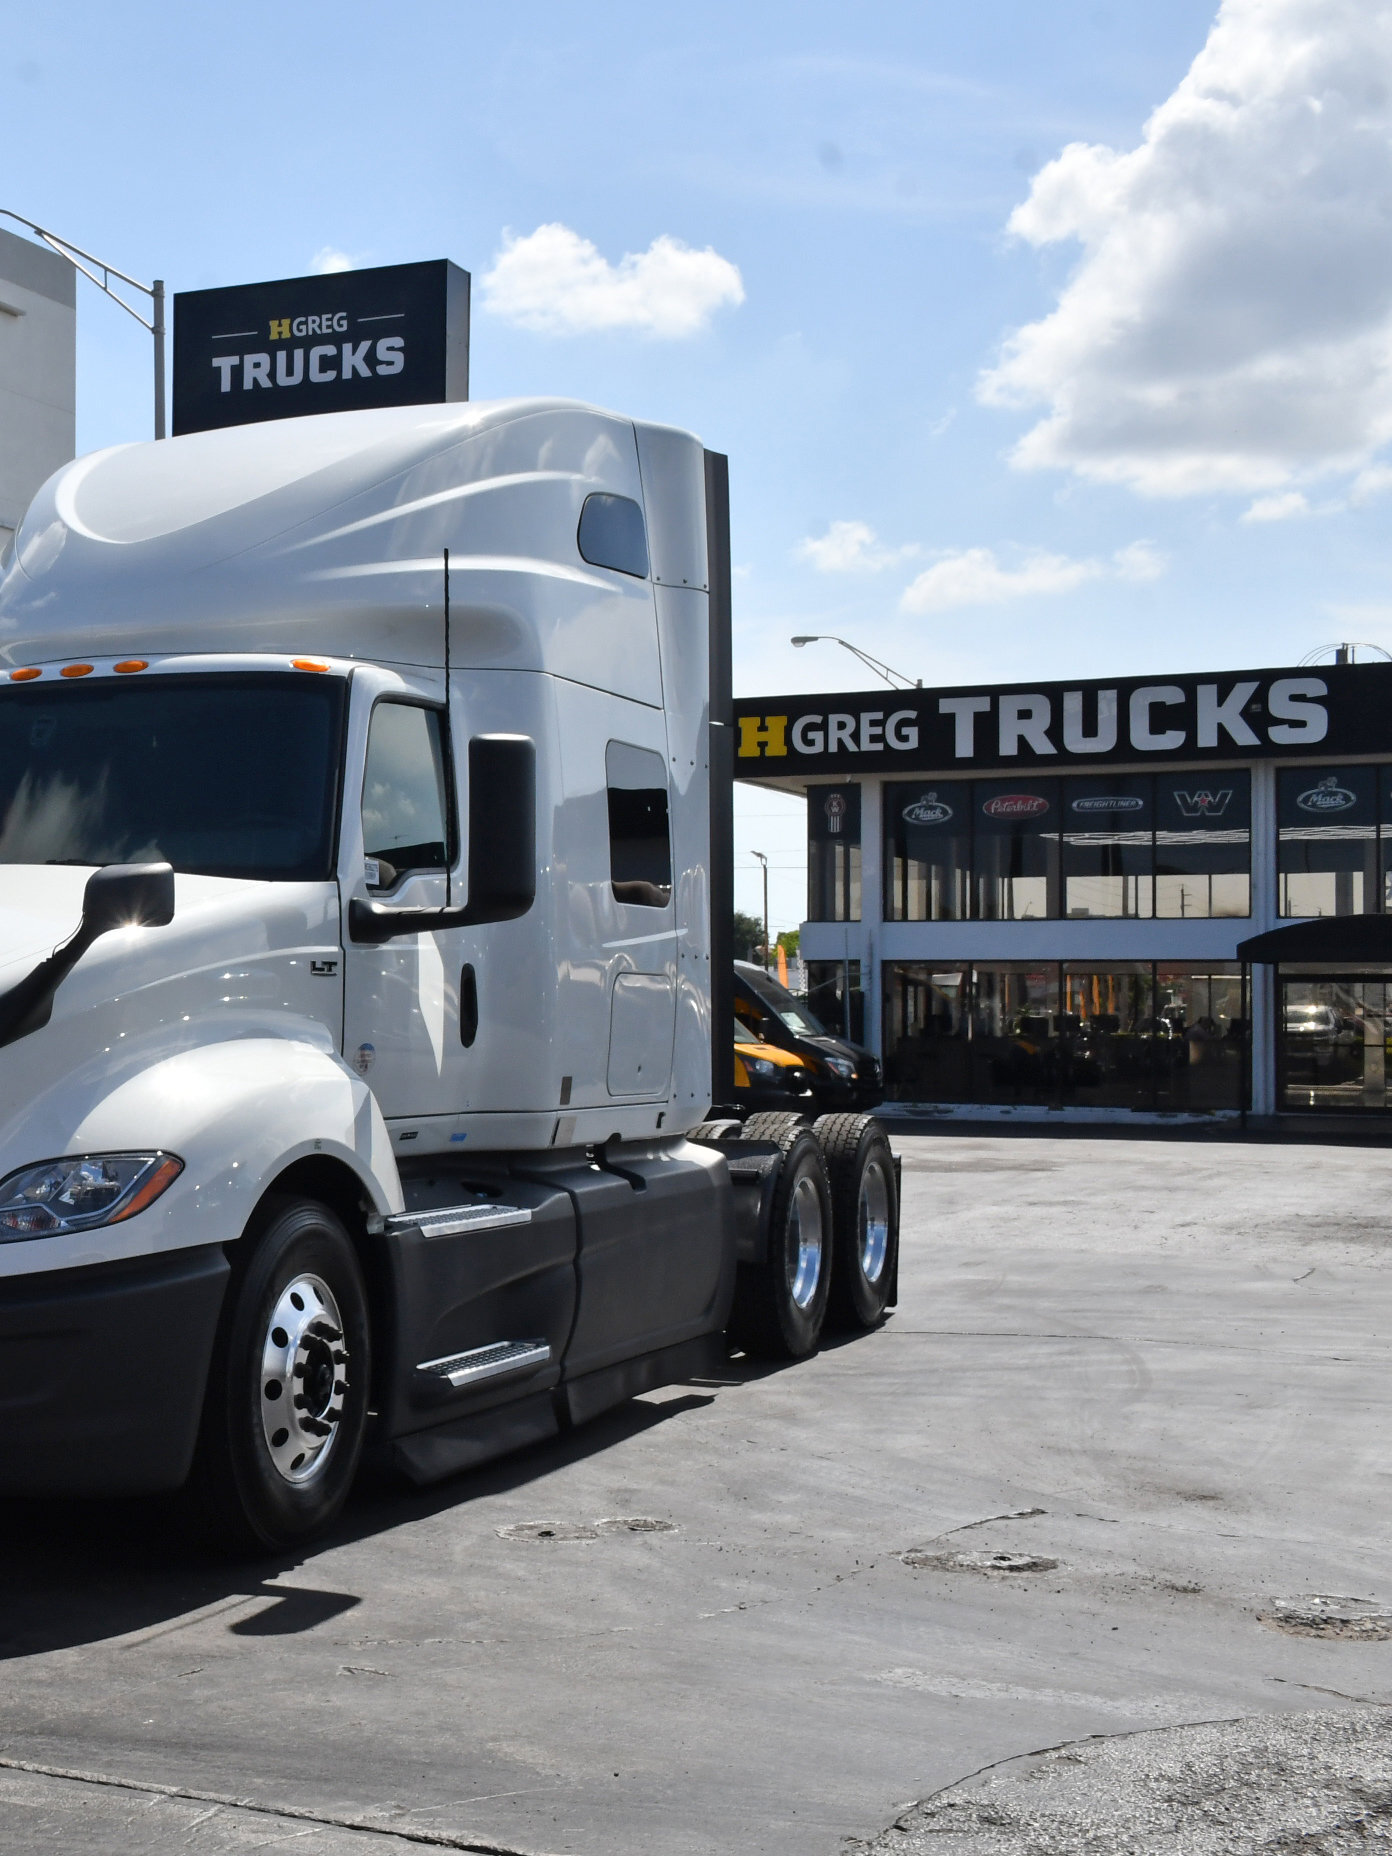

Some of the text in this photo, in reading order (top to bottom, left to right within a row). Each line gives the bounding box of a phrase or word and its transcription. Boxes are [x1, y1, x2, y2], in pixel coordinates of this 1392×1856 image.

[212, 336, 405, 393] TRUCKS
[939, 677, 1329, 759] TRUCKS
[991, 799, 1043, 814] Peterbilt
[1079, 800, 1136, 808] FREIGHTLINER
[1307, 793, 1346, 808] Mack
[911, 806, 944, 820] Mack
[311, 961, 338, 973] LT
